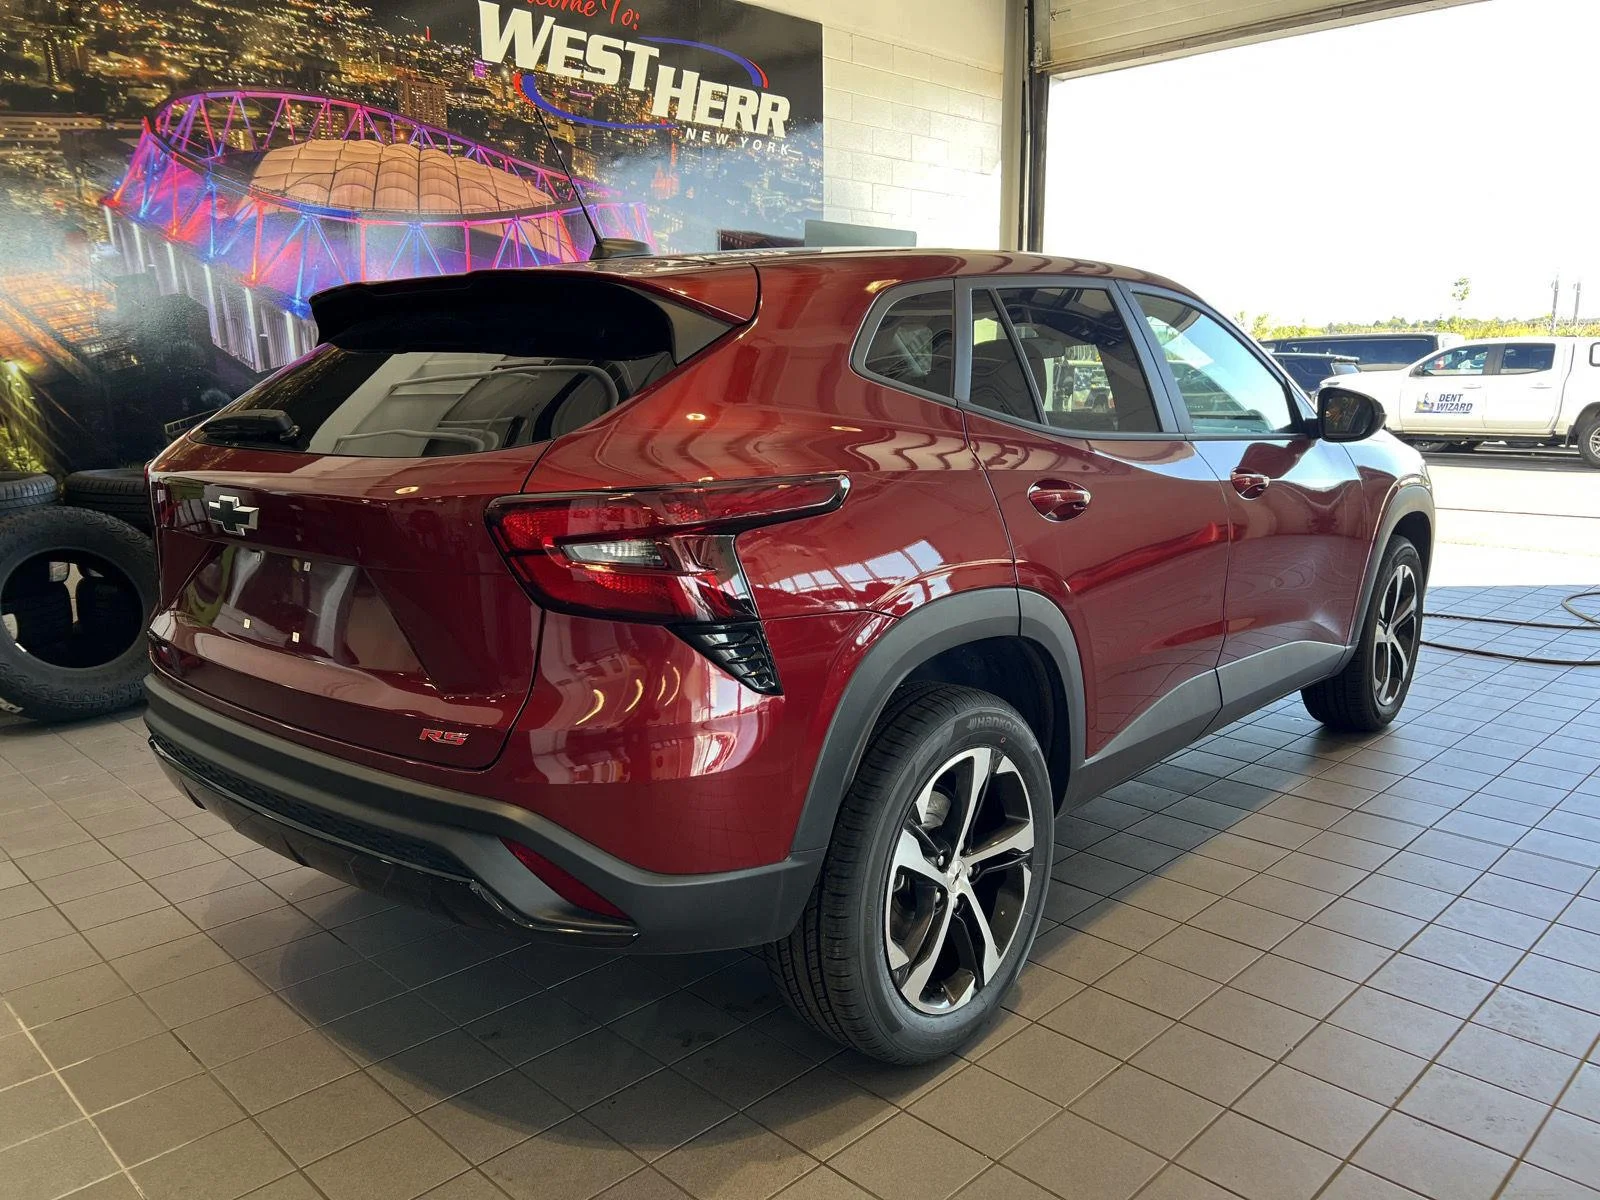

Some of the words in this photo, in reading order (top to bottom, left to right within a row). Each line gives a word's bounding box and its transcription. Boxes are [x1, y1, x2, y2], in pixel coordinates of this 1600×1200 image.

[602, 0, 640, 31] To:
[477, 0, 659, 91] WEST
[651, 64, 790, 138] HERR
[686, 128, 730, 145] NEW
[740, 136, 789, 156] YORK
[1436, 402, 1473, 412] WIZARD
[1438, 393, 1464, 402] DENT
[976, 715, 1022, 735] Hankoo
[419, 728, 469, 746] RS
